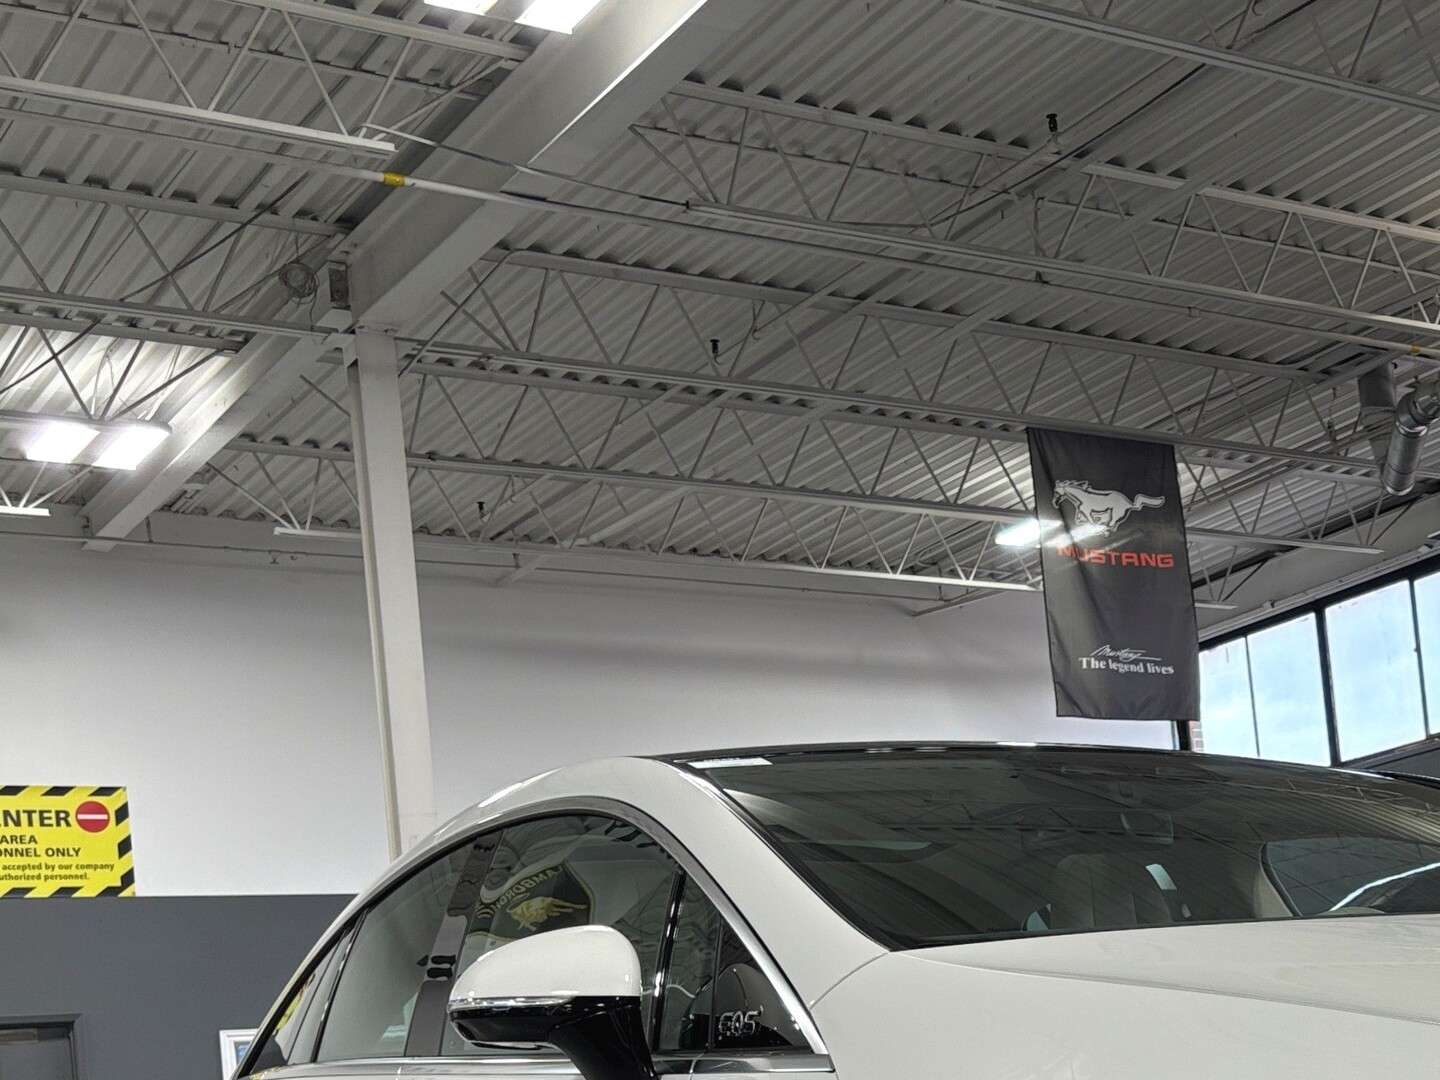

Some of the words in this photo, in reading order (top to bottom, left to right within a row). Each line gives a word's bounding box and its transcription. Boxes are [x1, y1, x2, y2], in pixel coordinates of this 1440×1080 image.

[1056, 544, 1174, 568] MUSTANG
[1079, 657, 1106, 669] The
[1108, 659, 1145, 674] legend
[1146, 662, 1175, 675] lives
[0, 809, 72, 828] NTER
[0, 835, 38, 845] AREA
[0, 847, 41, 858] NNEL
[45, 847, 81, 858] ONLY
[2, 862, 42, 872] accepted
[45, 862, 56, 872] by
[75, 863, 115, 872] company
[44, 872, 90, 882] personnel.
